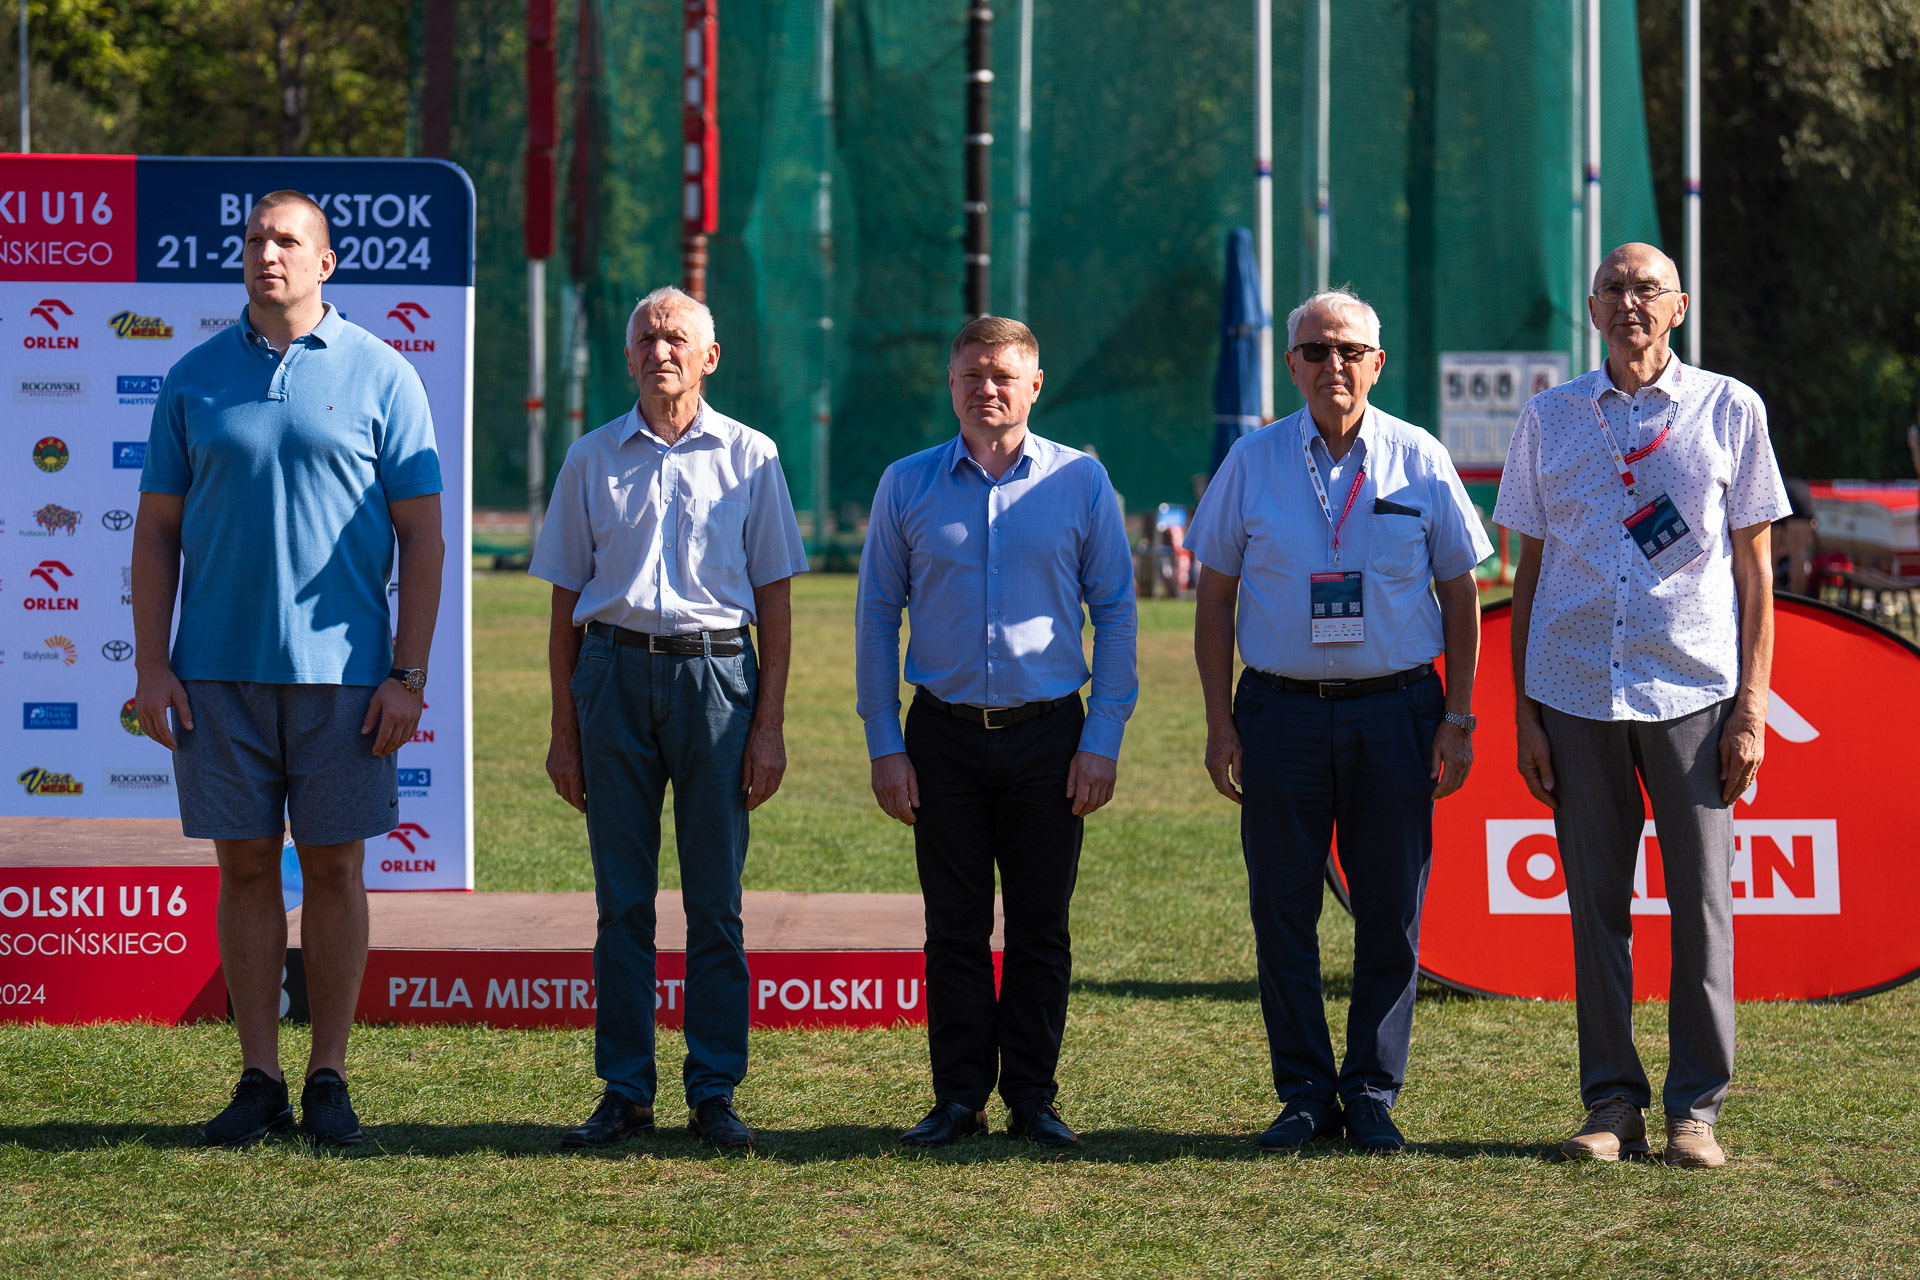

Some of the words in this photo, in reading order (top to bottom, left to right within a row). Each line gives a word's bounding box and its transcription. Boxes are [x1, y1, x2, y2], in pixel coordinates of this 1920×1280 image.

[42, 191, 113, 225] U16
[220, 193, 432, 228] BIYSTOK
[110, 311, 162, 337] Vega
[200, 317, 239, 328] ROGOW
[131, 326, 173, 338] MEBLE
[24, 336, 79, 350] ORLEN
[21, 381, 81, 392] ROGOWSKI
[123, 381, 147, 391] TVP
[118, 397, 158, 405] BIAŁYSTO
[23, 597, 79, 610] ORLEN
[23, 650, 60, 662] Białystok
[20, 768, 71, 794] Vega
[110, 774, 169, 783] ROGOWSKI
[41, 783, 82, 793] MEBLE
[398, 789, 428, 798] YSTOK
[380, 860, 436, 873] ORLEN
[0, 886, 104, 918] OLSKI
[119, 885, 187, 917] U16
[0, 927, 187, 956] SOCIŃSKIEGO
[388, 978, 474, 1009] PZLA
[758, 978, 882, 1011] POLSKI
